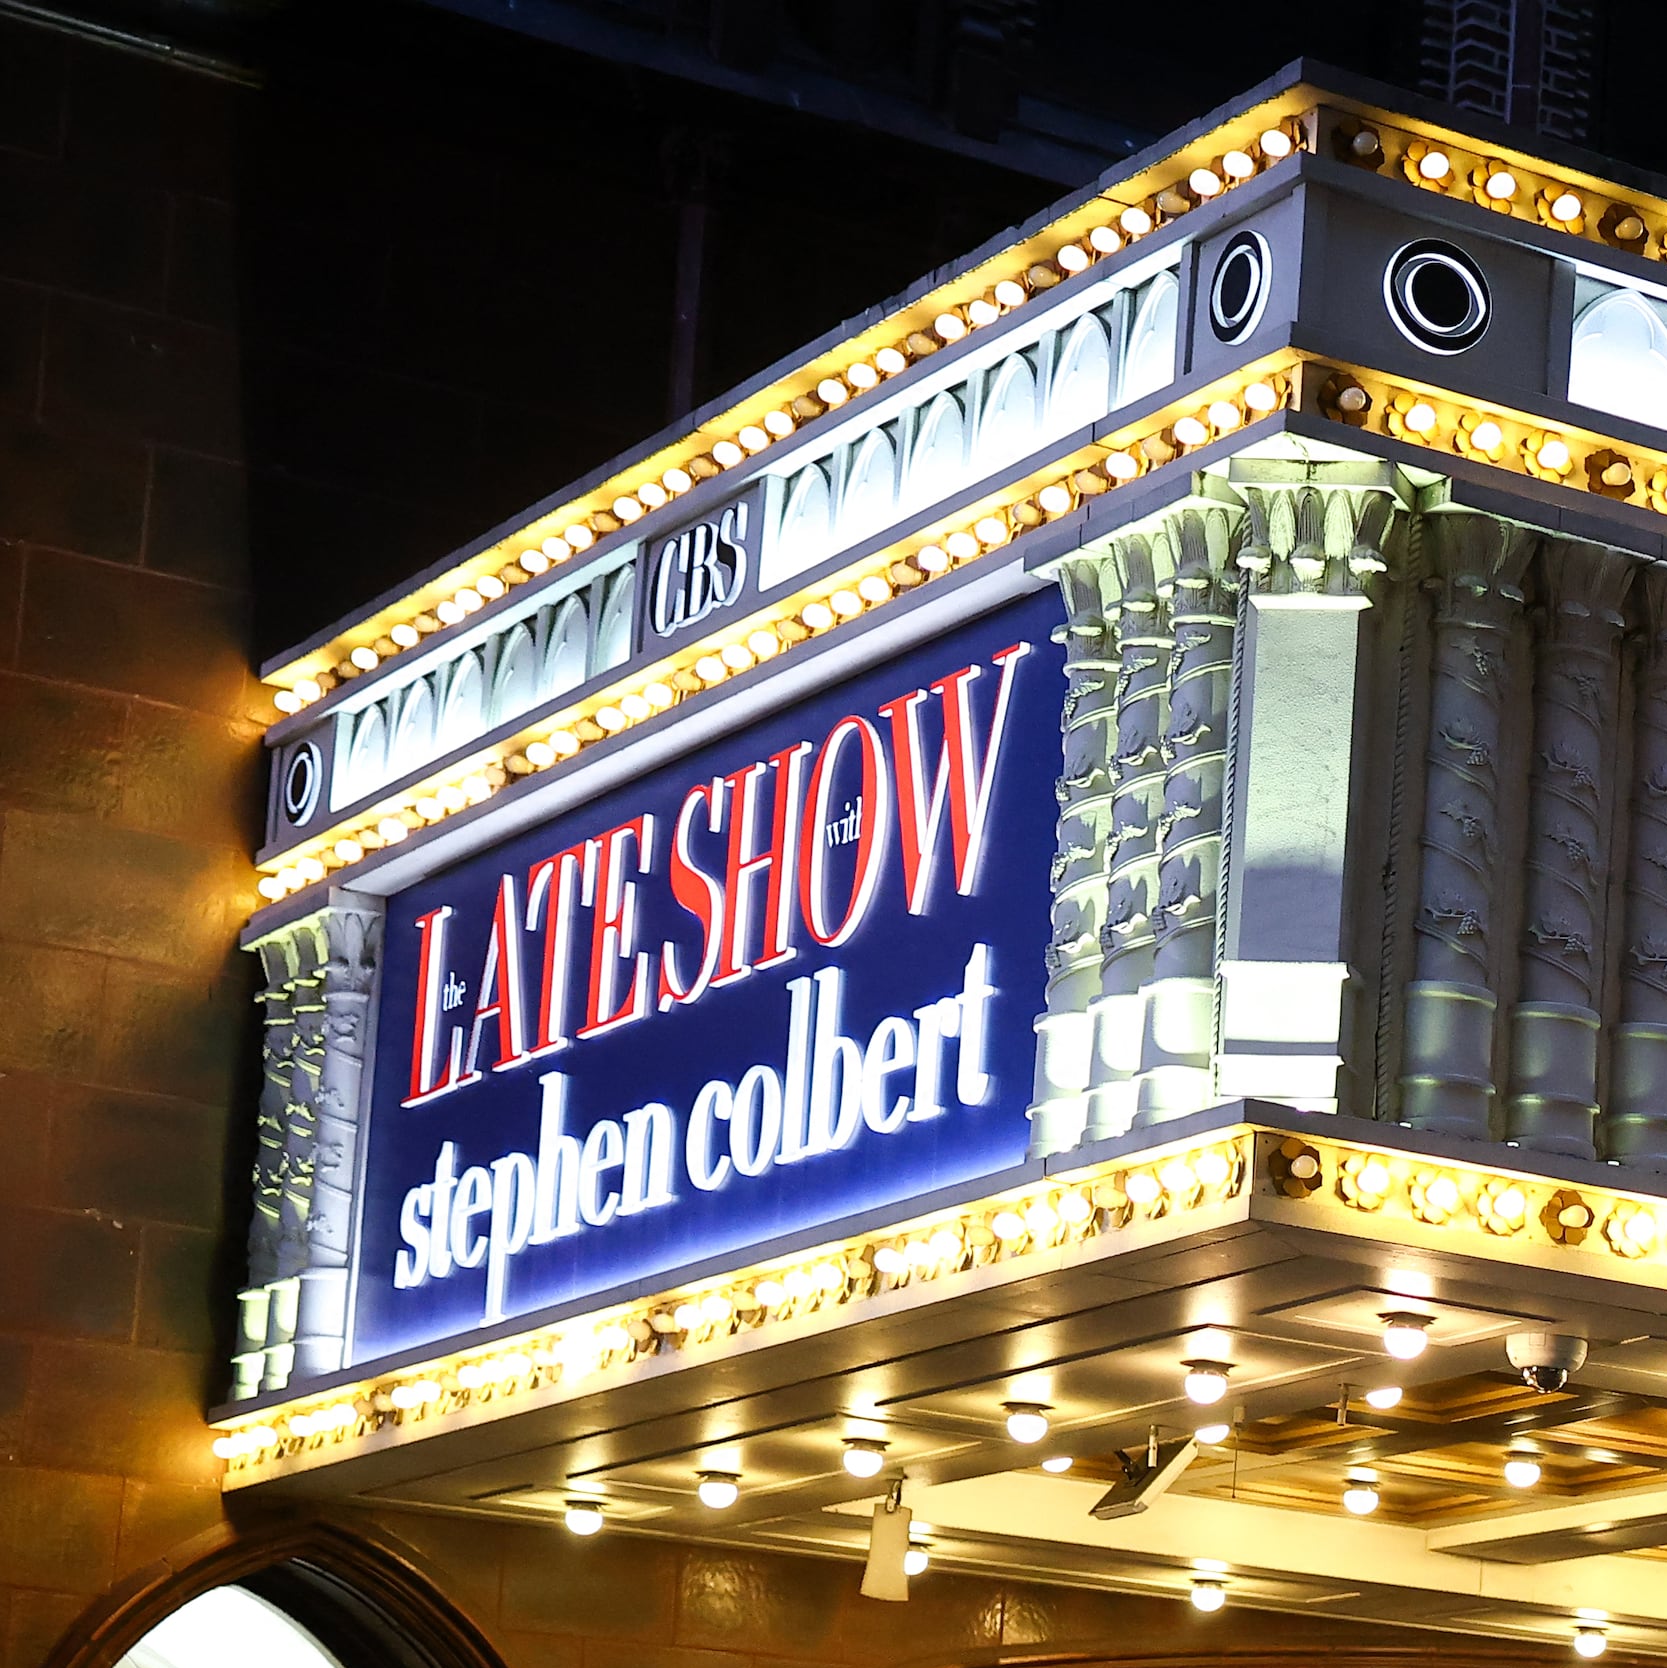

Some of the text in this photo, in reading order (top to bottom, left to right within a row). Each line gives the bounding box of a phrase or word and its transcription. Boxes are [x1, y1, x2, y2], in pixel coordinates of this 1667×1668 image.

[653, 499, 748, 638] CBS
[402, 642, 1030, 1108] LATE SHOW
[441, 972, 467, 1012] the
[392, 942, 998, 1330] stephen colbert
